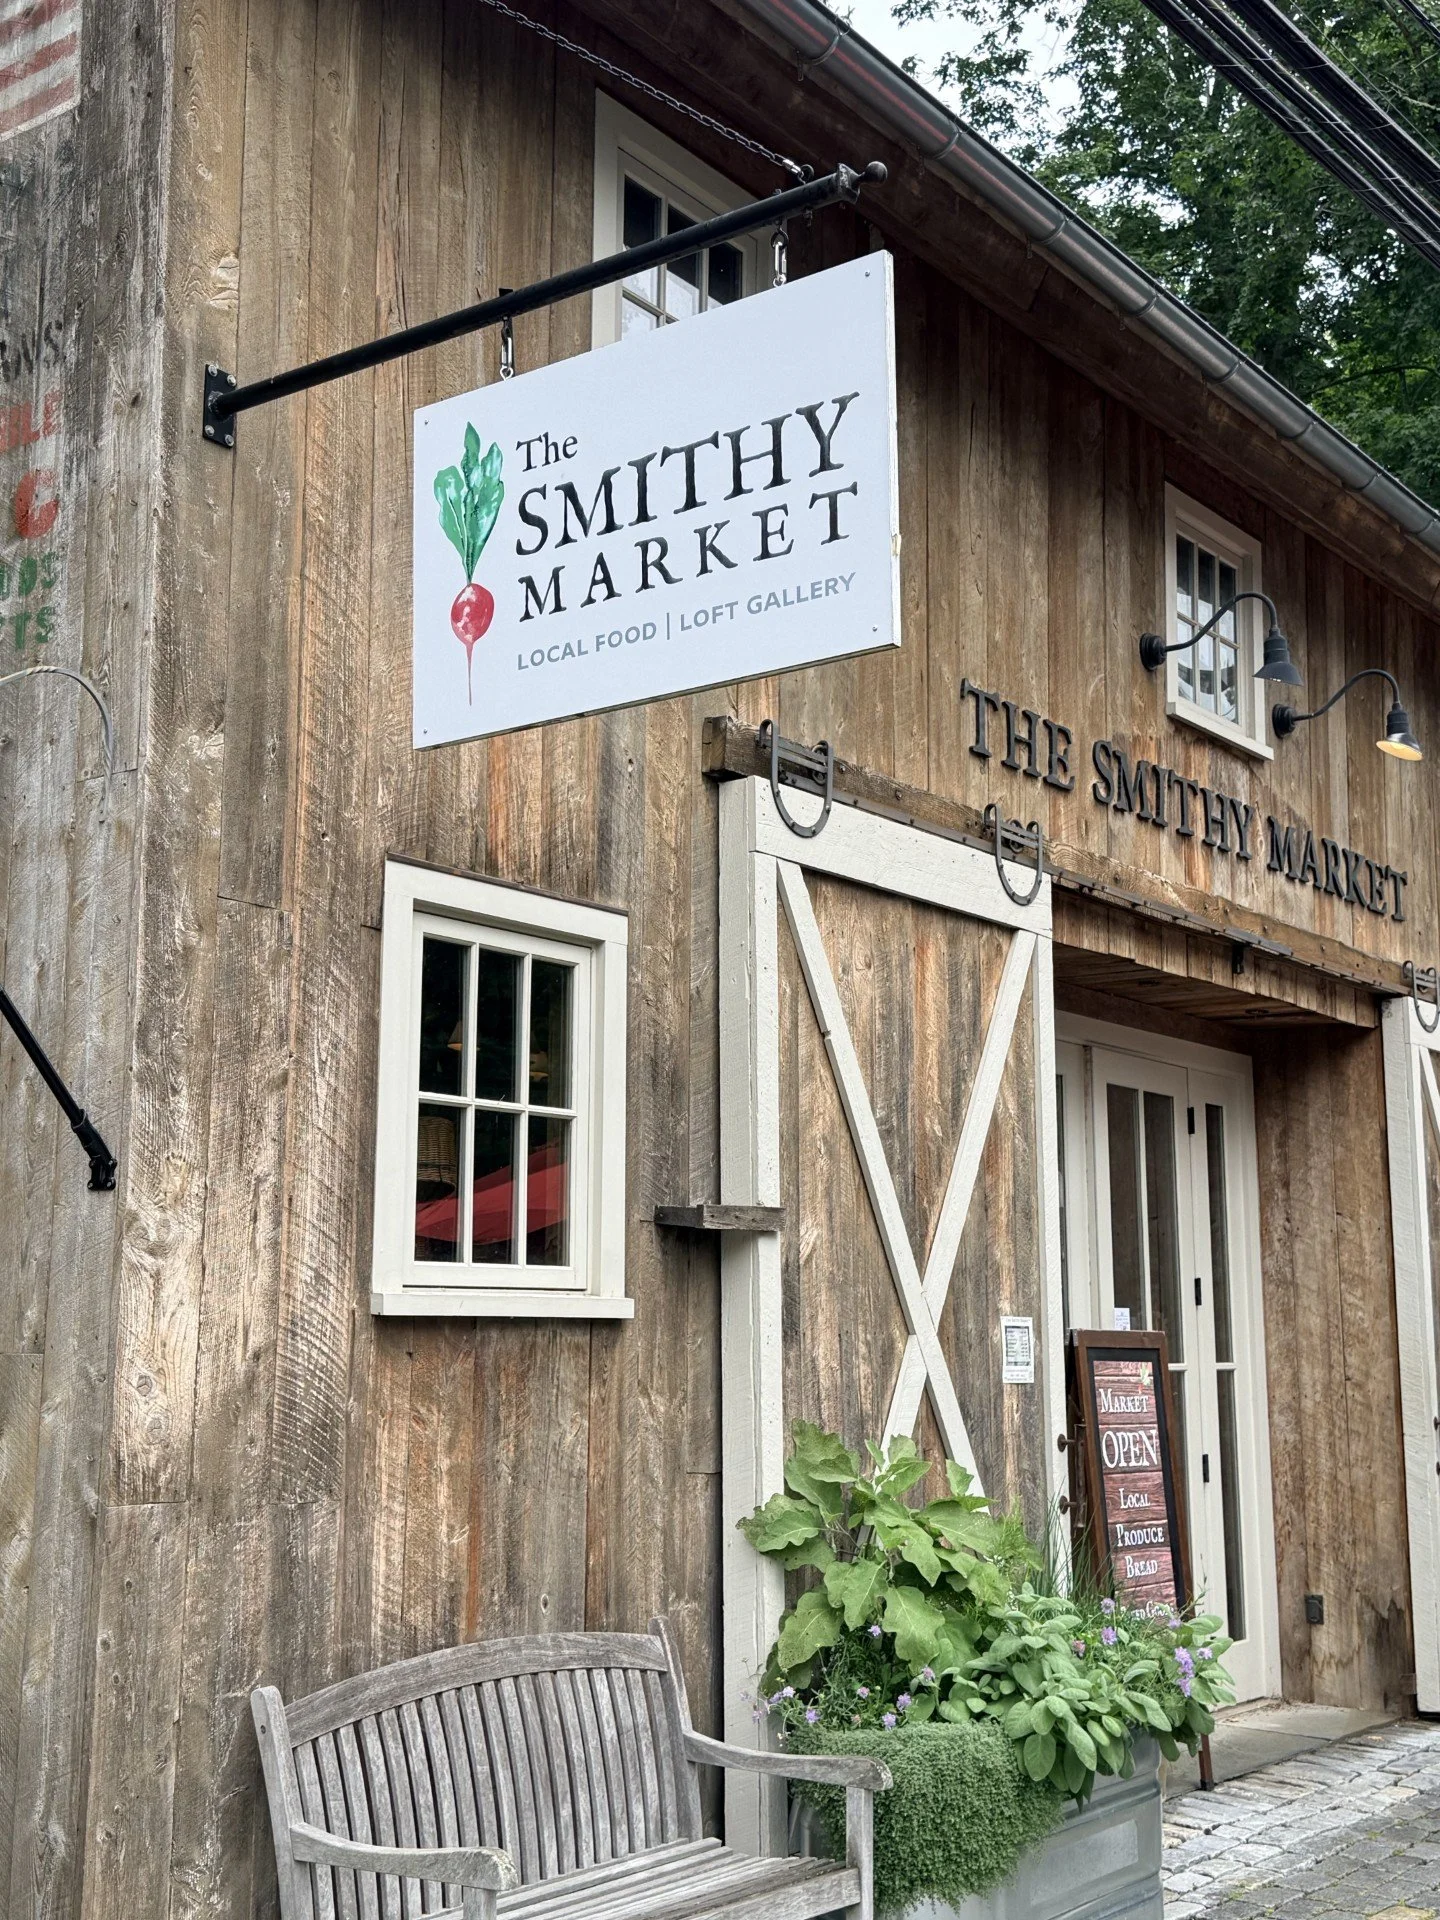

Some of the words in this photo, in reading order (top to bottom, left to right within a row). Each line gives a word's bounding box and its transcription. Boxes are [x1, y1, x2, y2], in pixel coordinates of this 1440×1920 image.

[515, 391, 861, 557] SMITHY
[516, 431, 578, 473] The
[518, 481, 859, 623] MARKET
[517, 638, 589, 671] LOCAL
[595, 622, 657, 652] FOOD
[680, 601, 739, 632] LOFT
[747, 572, 857, 614] GALLERY
[960, 677, 1075, 791] THE
[1092, 740, 1255, 860] SMITHY
[1267, 815, 1408, 922] MARKET
[1102, 1430, 1158, 1469] OPEN
